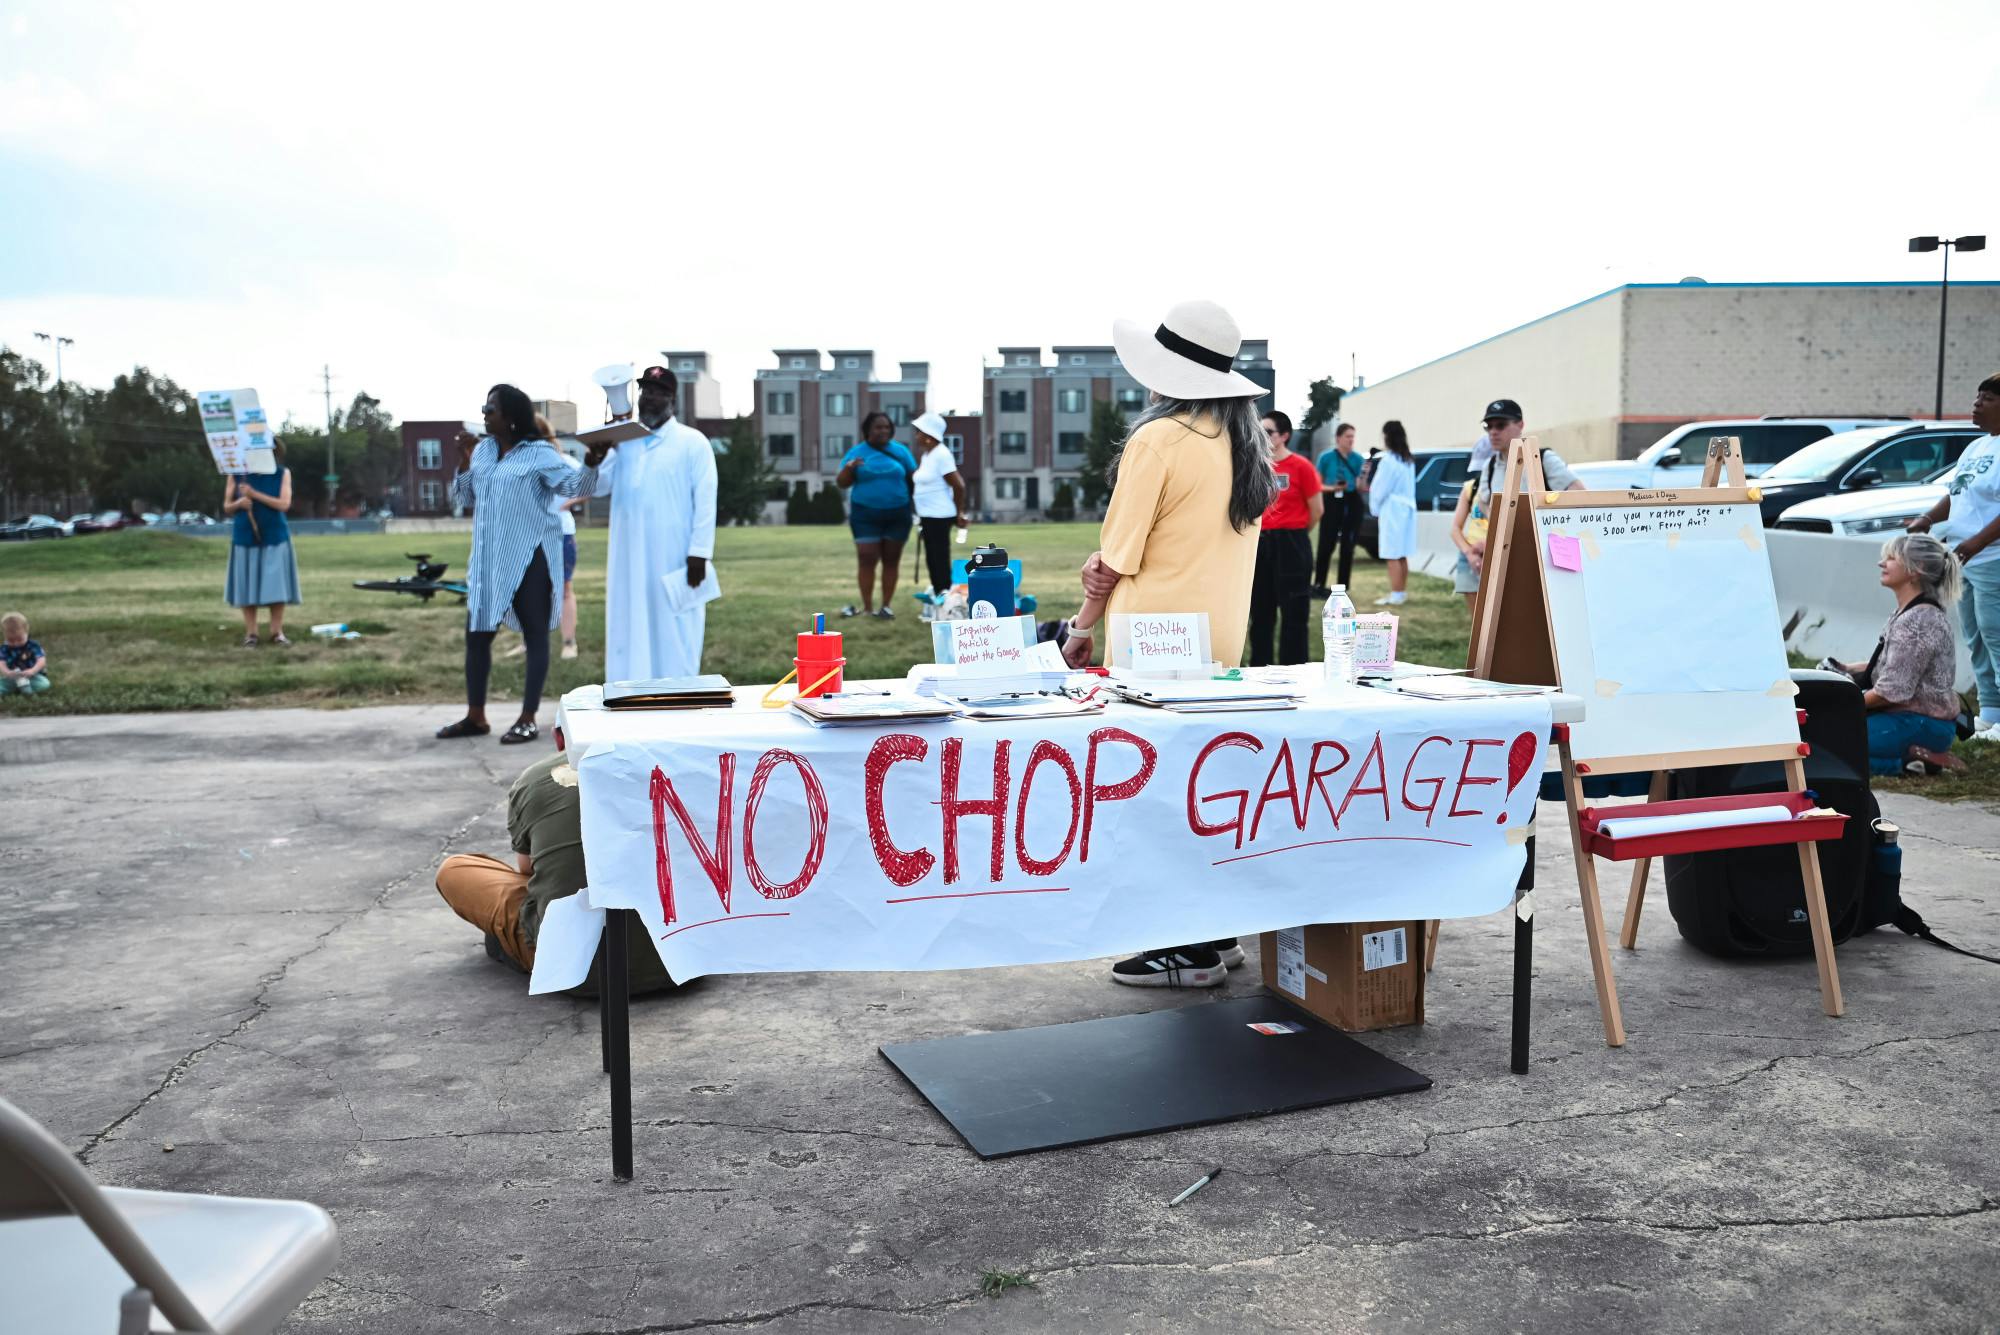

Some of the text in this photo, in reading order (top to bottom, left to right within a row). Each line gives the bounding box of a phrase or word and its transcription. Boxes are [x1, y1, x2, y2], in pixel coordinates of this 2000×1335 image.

[1542, 515, 1571, 526] What
[1580, 512, 1612, 523] would
[1623, 512, 1641, 524] you
[1650, 509, 1686, 519] rather
[1719, 508, 1733, 516] at
[1659, 520, 1682, 531] Ferry
[1687, 517, 1708, 527] Ave?
[1139, 638, 1192, 656] Petition!!
[959, 652, 979, 664] about
[982, 651, 994, 661] the
[651, 728, 1537, 923] NO CHOP GARAGE!
